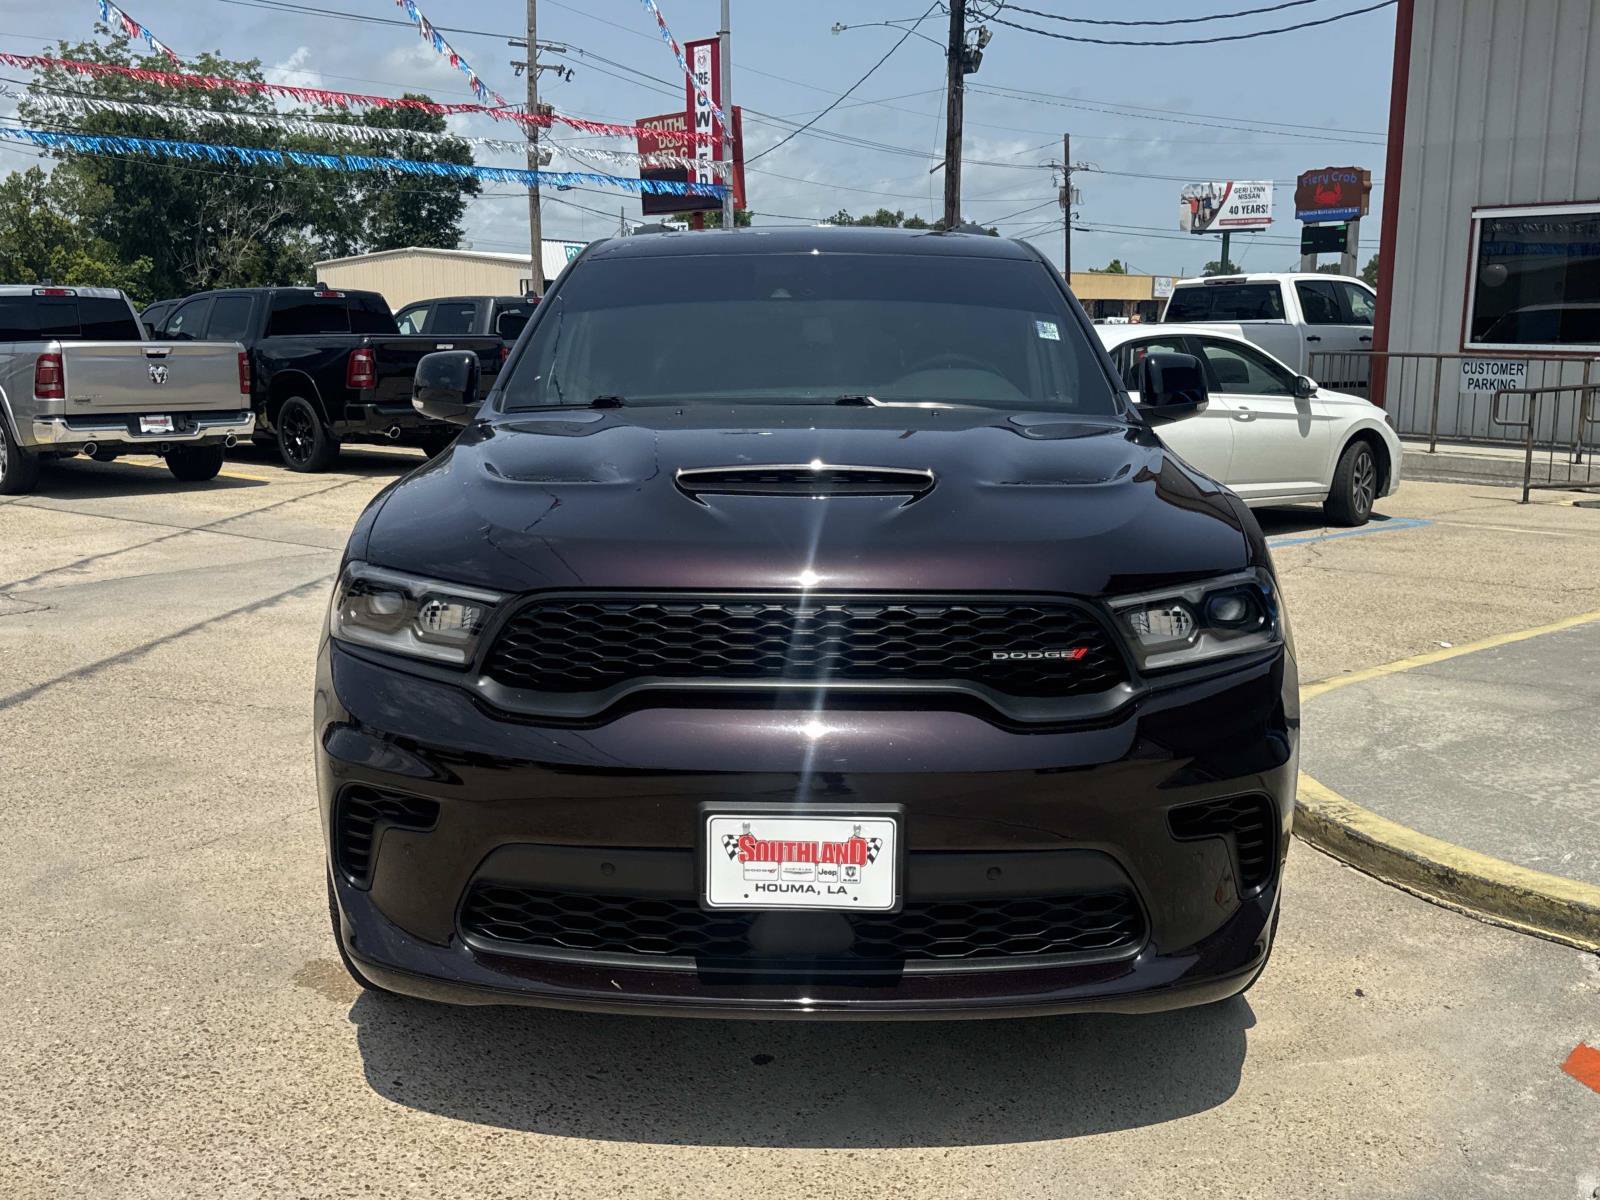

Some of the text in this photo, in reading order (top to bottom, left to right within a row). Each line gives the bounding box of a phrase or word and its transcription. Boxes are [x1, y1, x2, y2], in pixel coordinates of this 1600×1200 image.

[1331, 171, 1358, 183] Crab
[1229, 204, 1269, 215] 40 YEARS!
[1462, 362, 1524, 376] CUSTOMER
[1467, 378, 1517, 391] PARKING
[992, 651, 1075, 660] DODGE
[738, 834, 868, 867] SOUTHLAND
[817, 868, 838, 877] Jeep
[755, 883, 848, 896] HOUMA, LA
